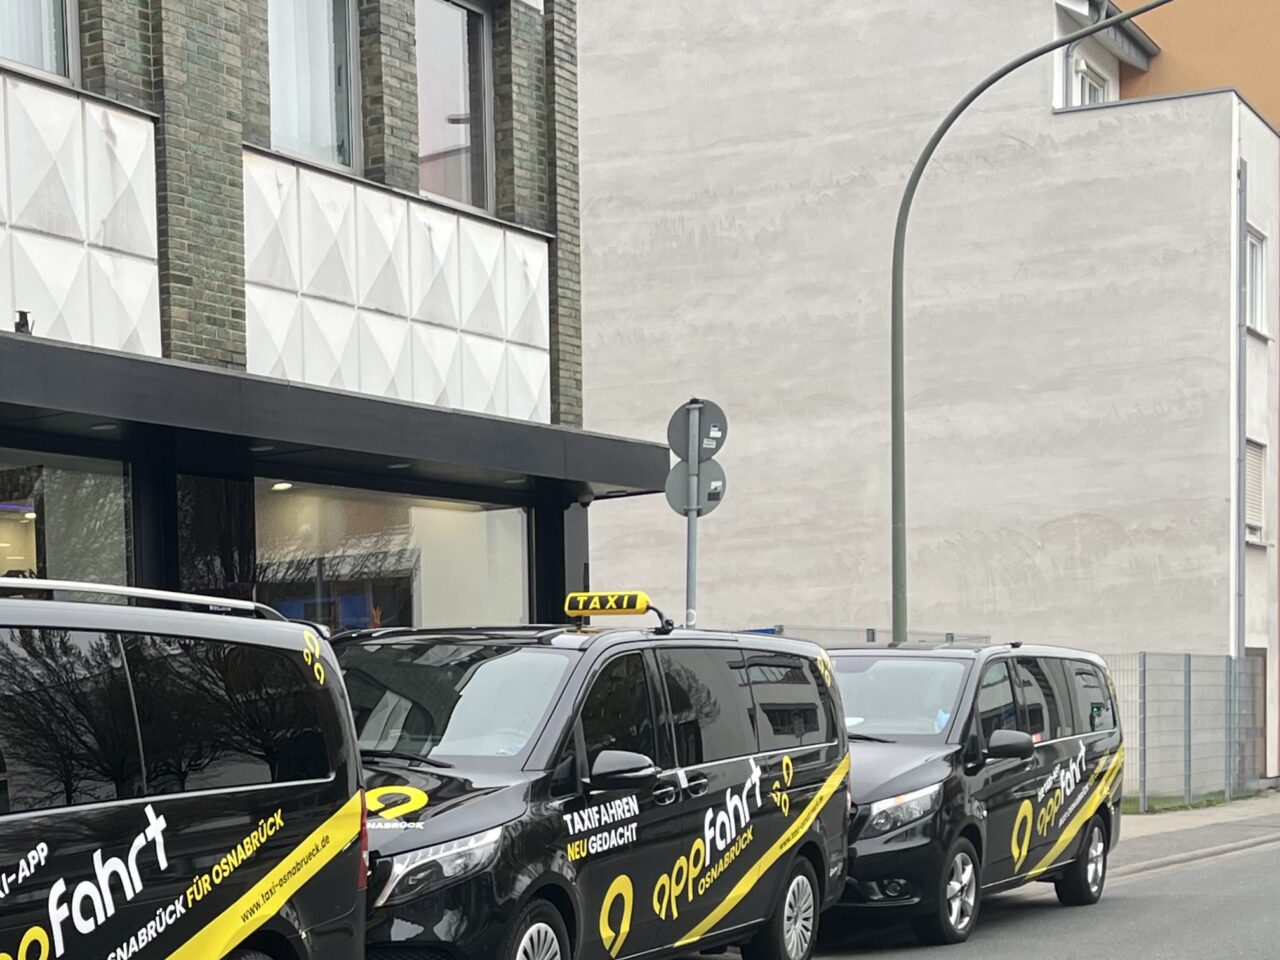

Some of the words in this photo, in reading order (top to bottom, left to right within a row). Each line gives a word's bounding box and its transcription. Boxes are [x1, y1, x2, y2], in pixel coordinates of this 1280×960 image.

[576, 595, 629, 610] TAXI
[562, 794, 640, 836] TAXIFAHREN
[566, 838, 588, 863] NEU
[588, 822, 638, 855] GEDACHT
[652, 757, 762, 921] appfahrt
[185, 875, 213, 909] FÜR
[212, 808, 285, 885] OSNABRÜCK
[240, 834, 331, 924] www.taxi-osnabrueck.de
[697, 825, 754, 896] OSNABRÜCK
